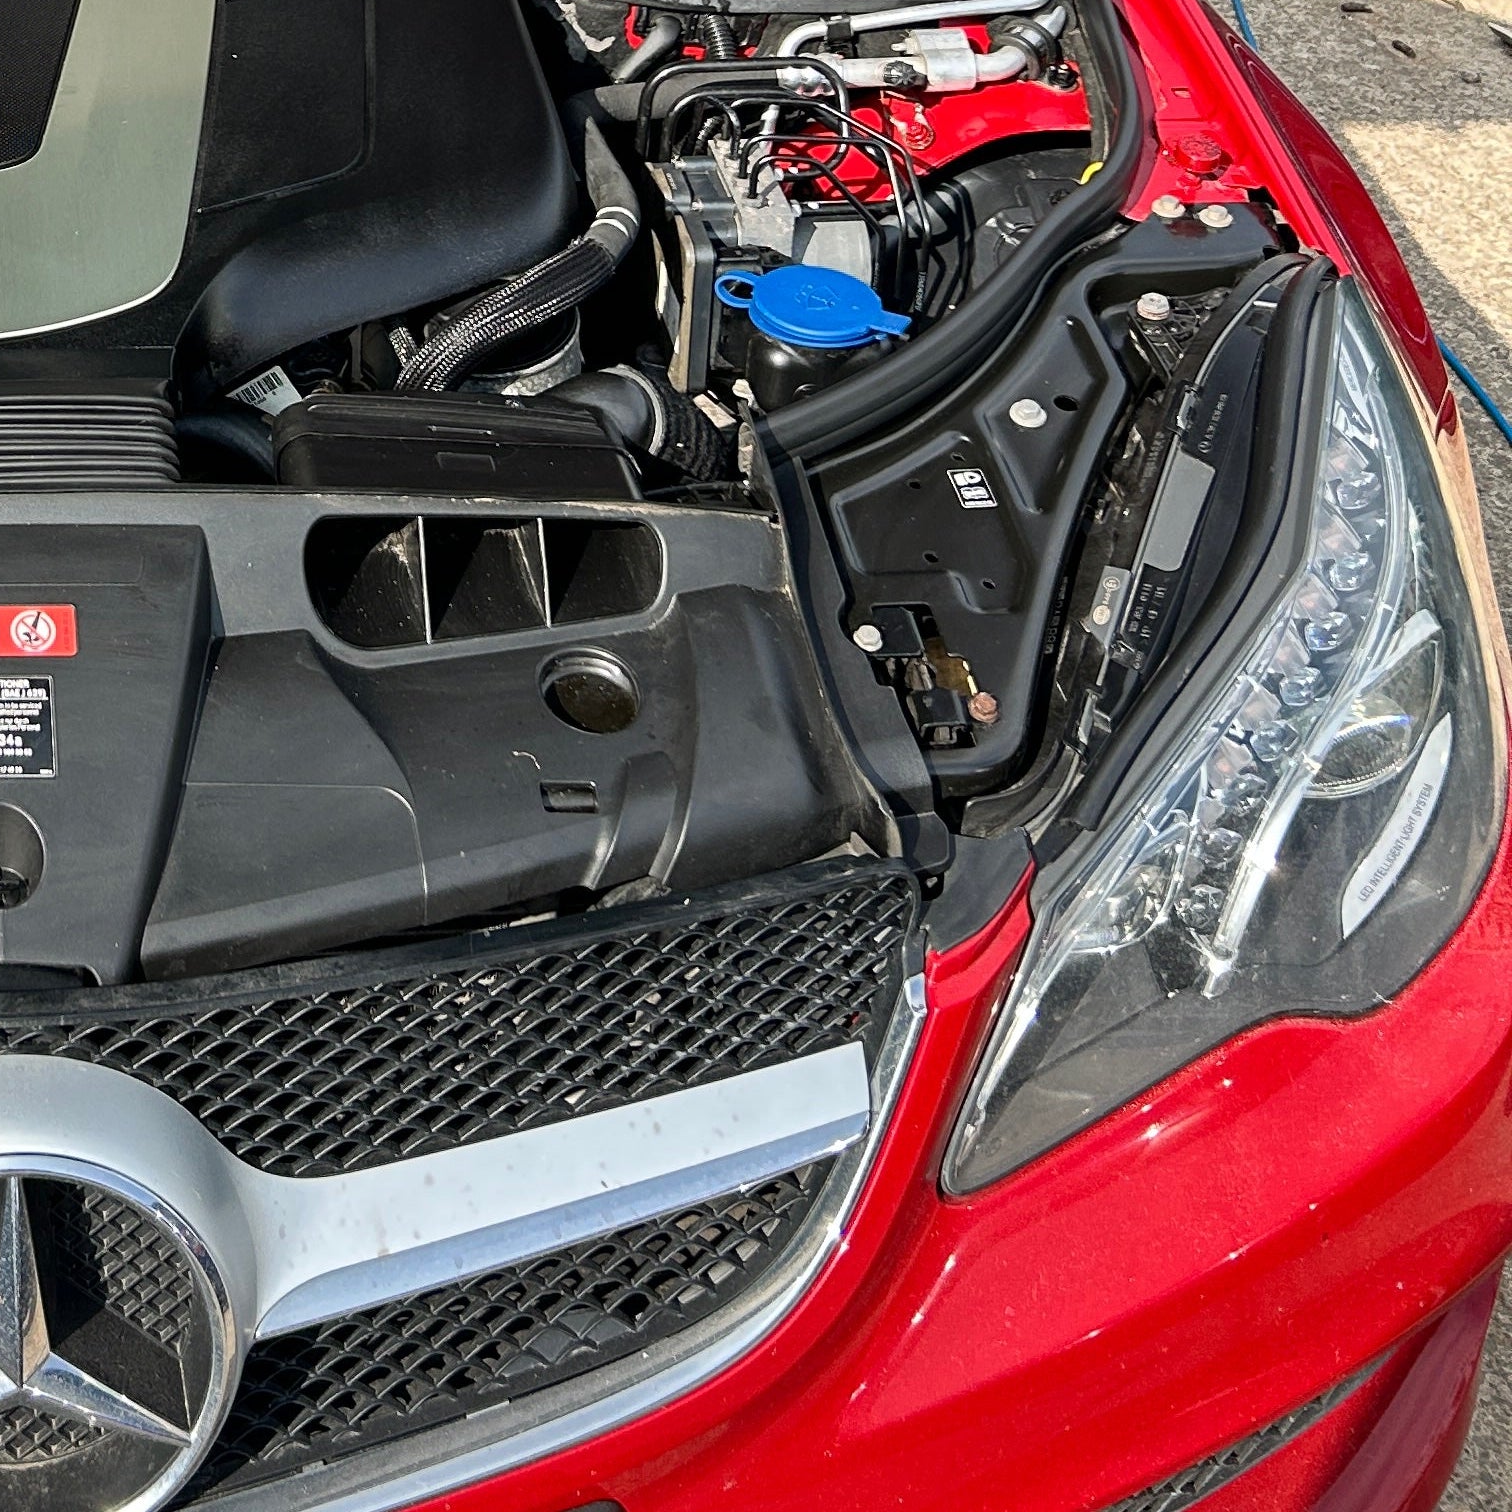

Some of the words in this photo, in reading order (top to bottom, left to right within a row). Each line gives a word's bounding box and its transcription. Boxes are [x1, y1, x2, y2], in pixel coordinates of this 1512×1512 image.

[1358, 884, 1373, 902] LED
[1369, 839, 1405, 889] INTELLIGENT
[1400, 815, 1417, 841] LIGHT
[1413, 783, 1433, 817] SYSTEM
